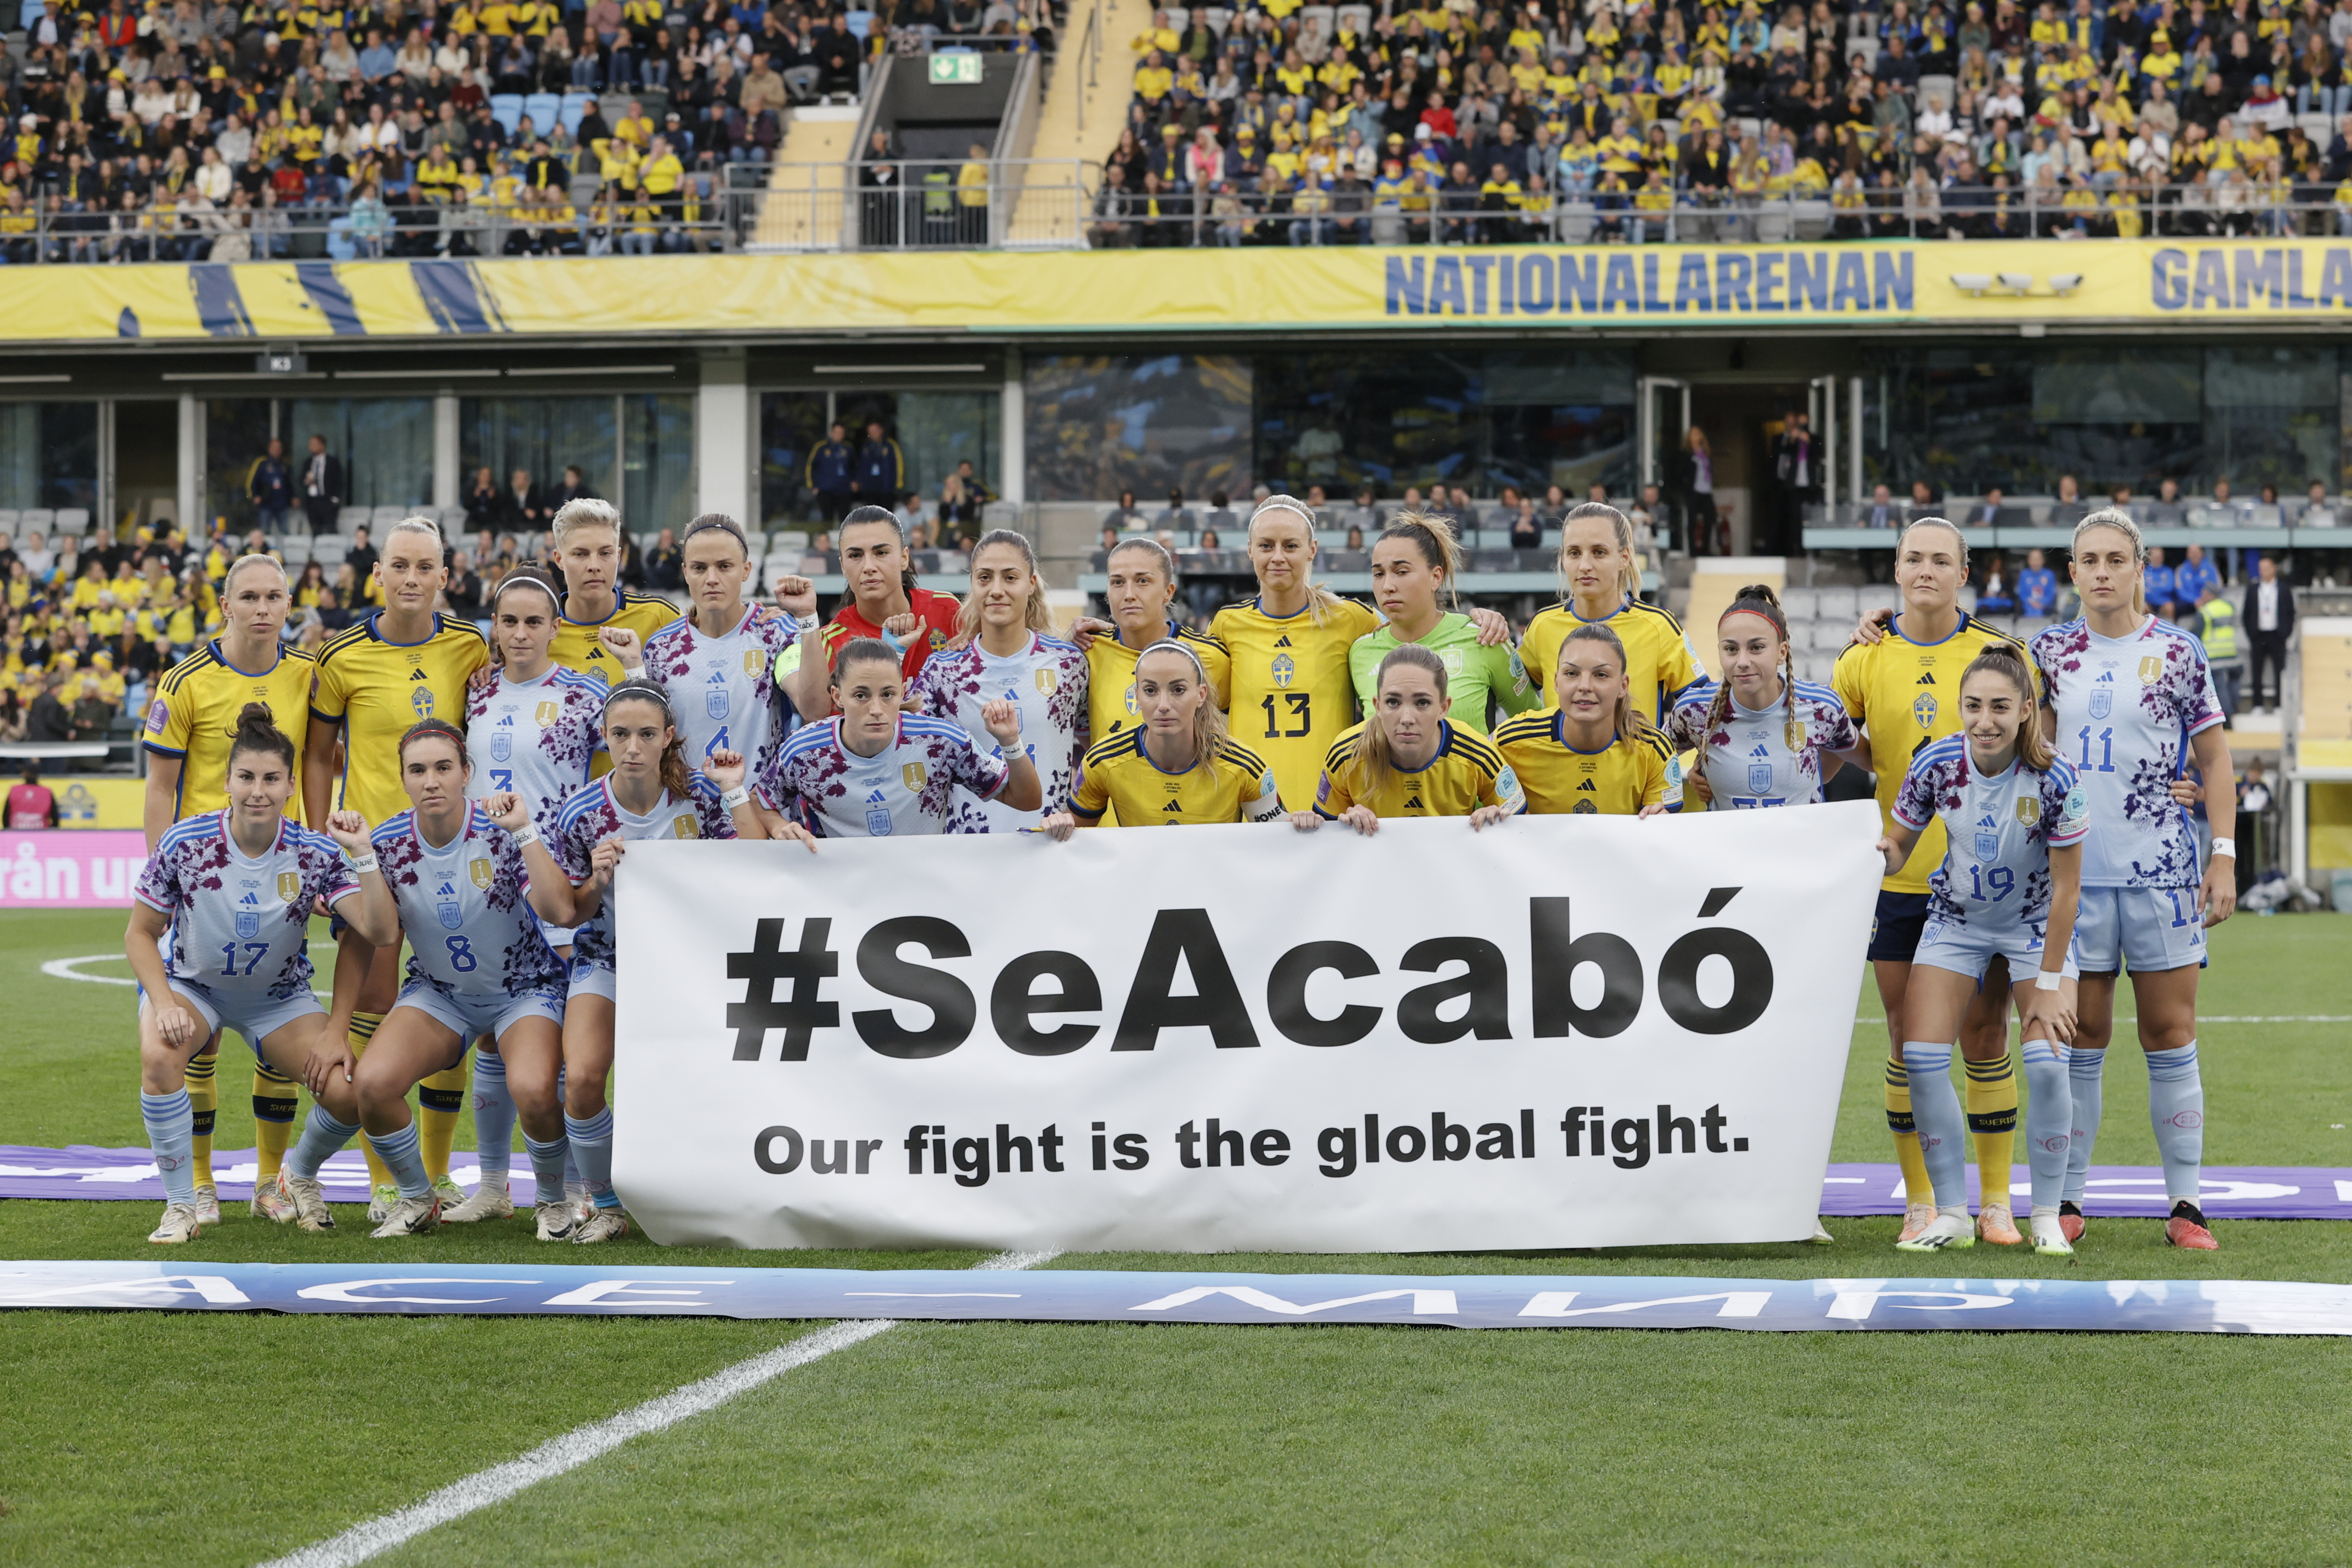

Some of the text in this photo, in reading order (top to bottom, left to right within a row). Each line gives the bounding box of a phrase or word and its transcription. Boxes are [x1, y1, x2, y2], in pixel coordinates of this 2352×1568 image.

[1388, 254, 1913, 313] NATIONALARENAN
[2152, 250, 2352, 310] GAMLA
[1261, 693, 1310, 738] 13
[2078, 724, 2116, 774] 11
[1254, 805, 1281, 822] #ONE
[1970, 863, 2015, 903] 19
[2165, 887, 2199, 930] 11
[221, 941, 269, 976] 17
[445, 934, 478, 973] 8
[727, 887, 1773, 1061] #SeAcabó
[754, 1104, 1748, 1187] Our fight is the global fight.
